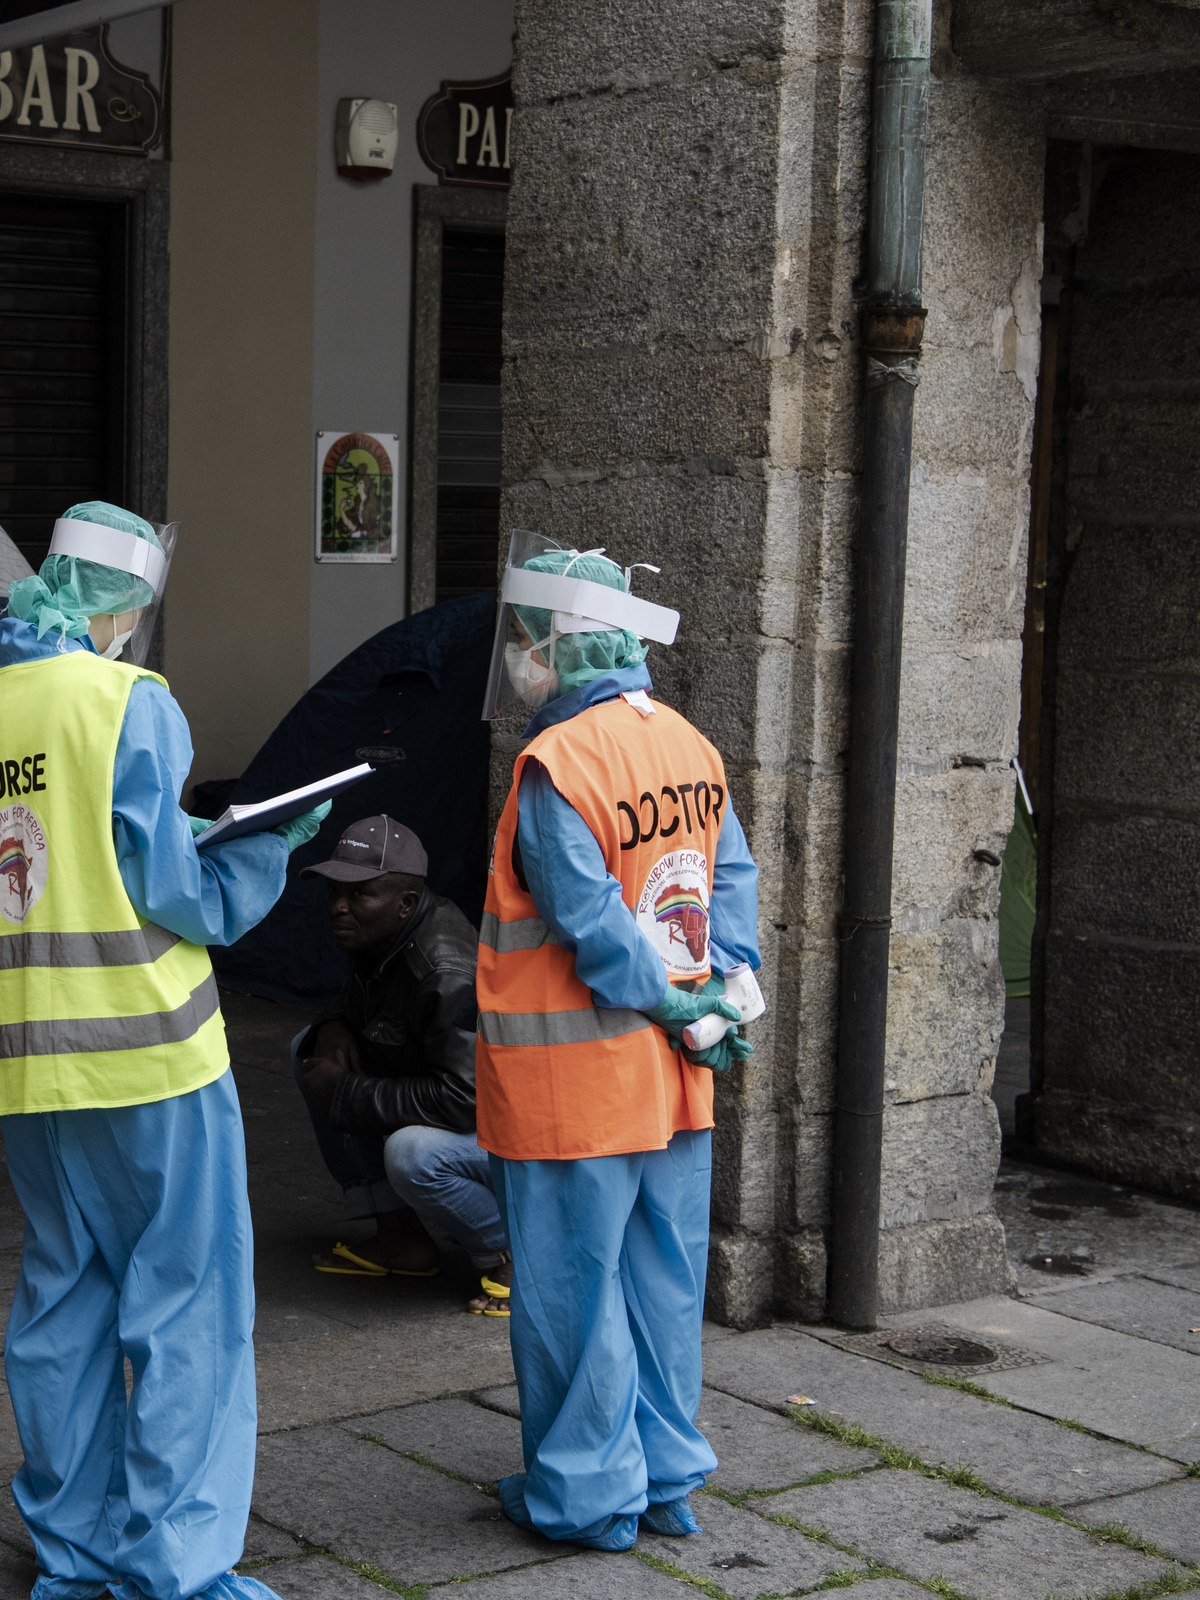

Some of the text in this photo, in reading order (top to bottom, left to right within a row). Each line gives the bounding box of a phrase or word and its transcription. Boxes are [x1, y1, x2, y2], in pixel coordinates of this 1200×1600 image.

[12, 806, 25, 820] FOR
[24, 811, 46, 851] AFRICA
[616, 780, 724, 851] DOCTOR
[639, 855, 674, 913] R@INBOW
[680, 853, 699, 868] FOR
